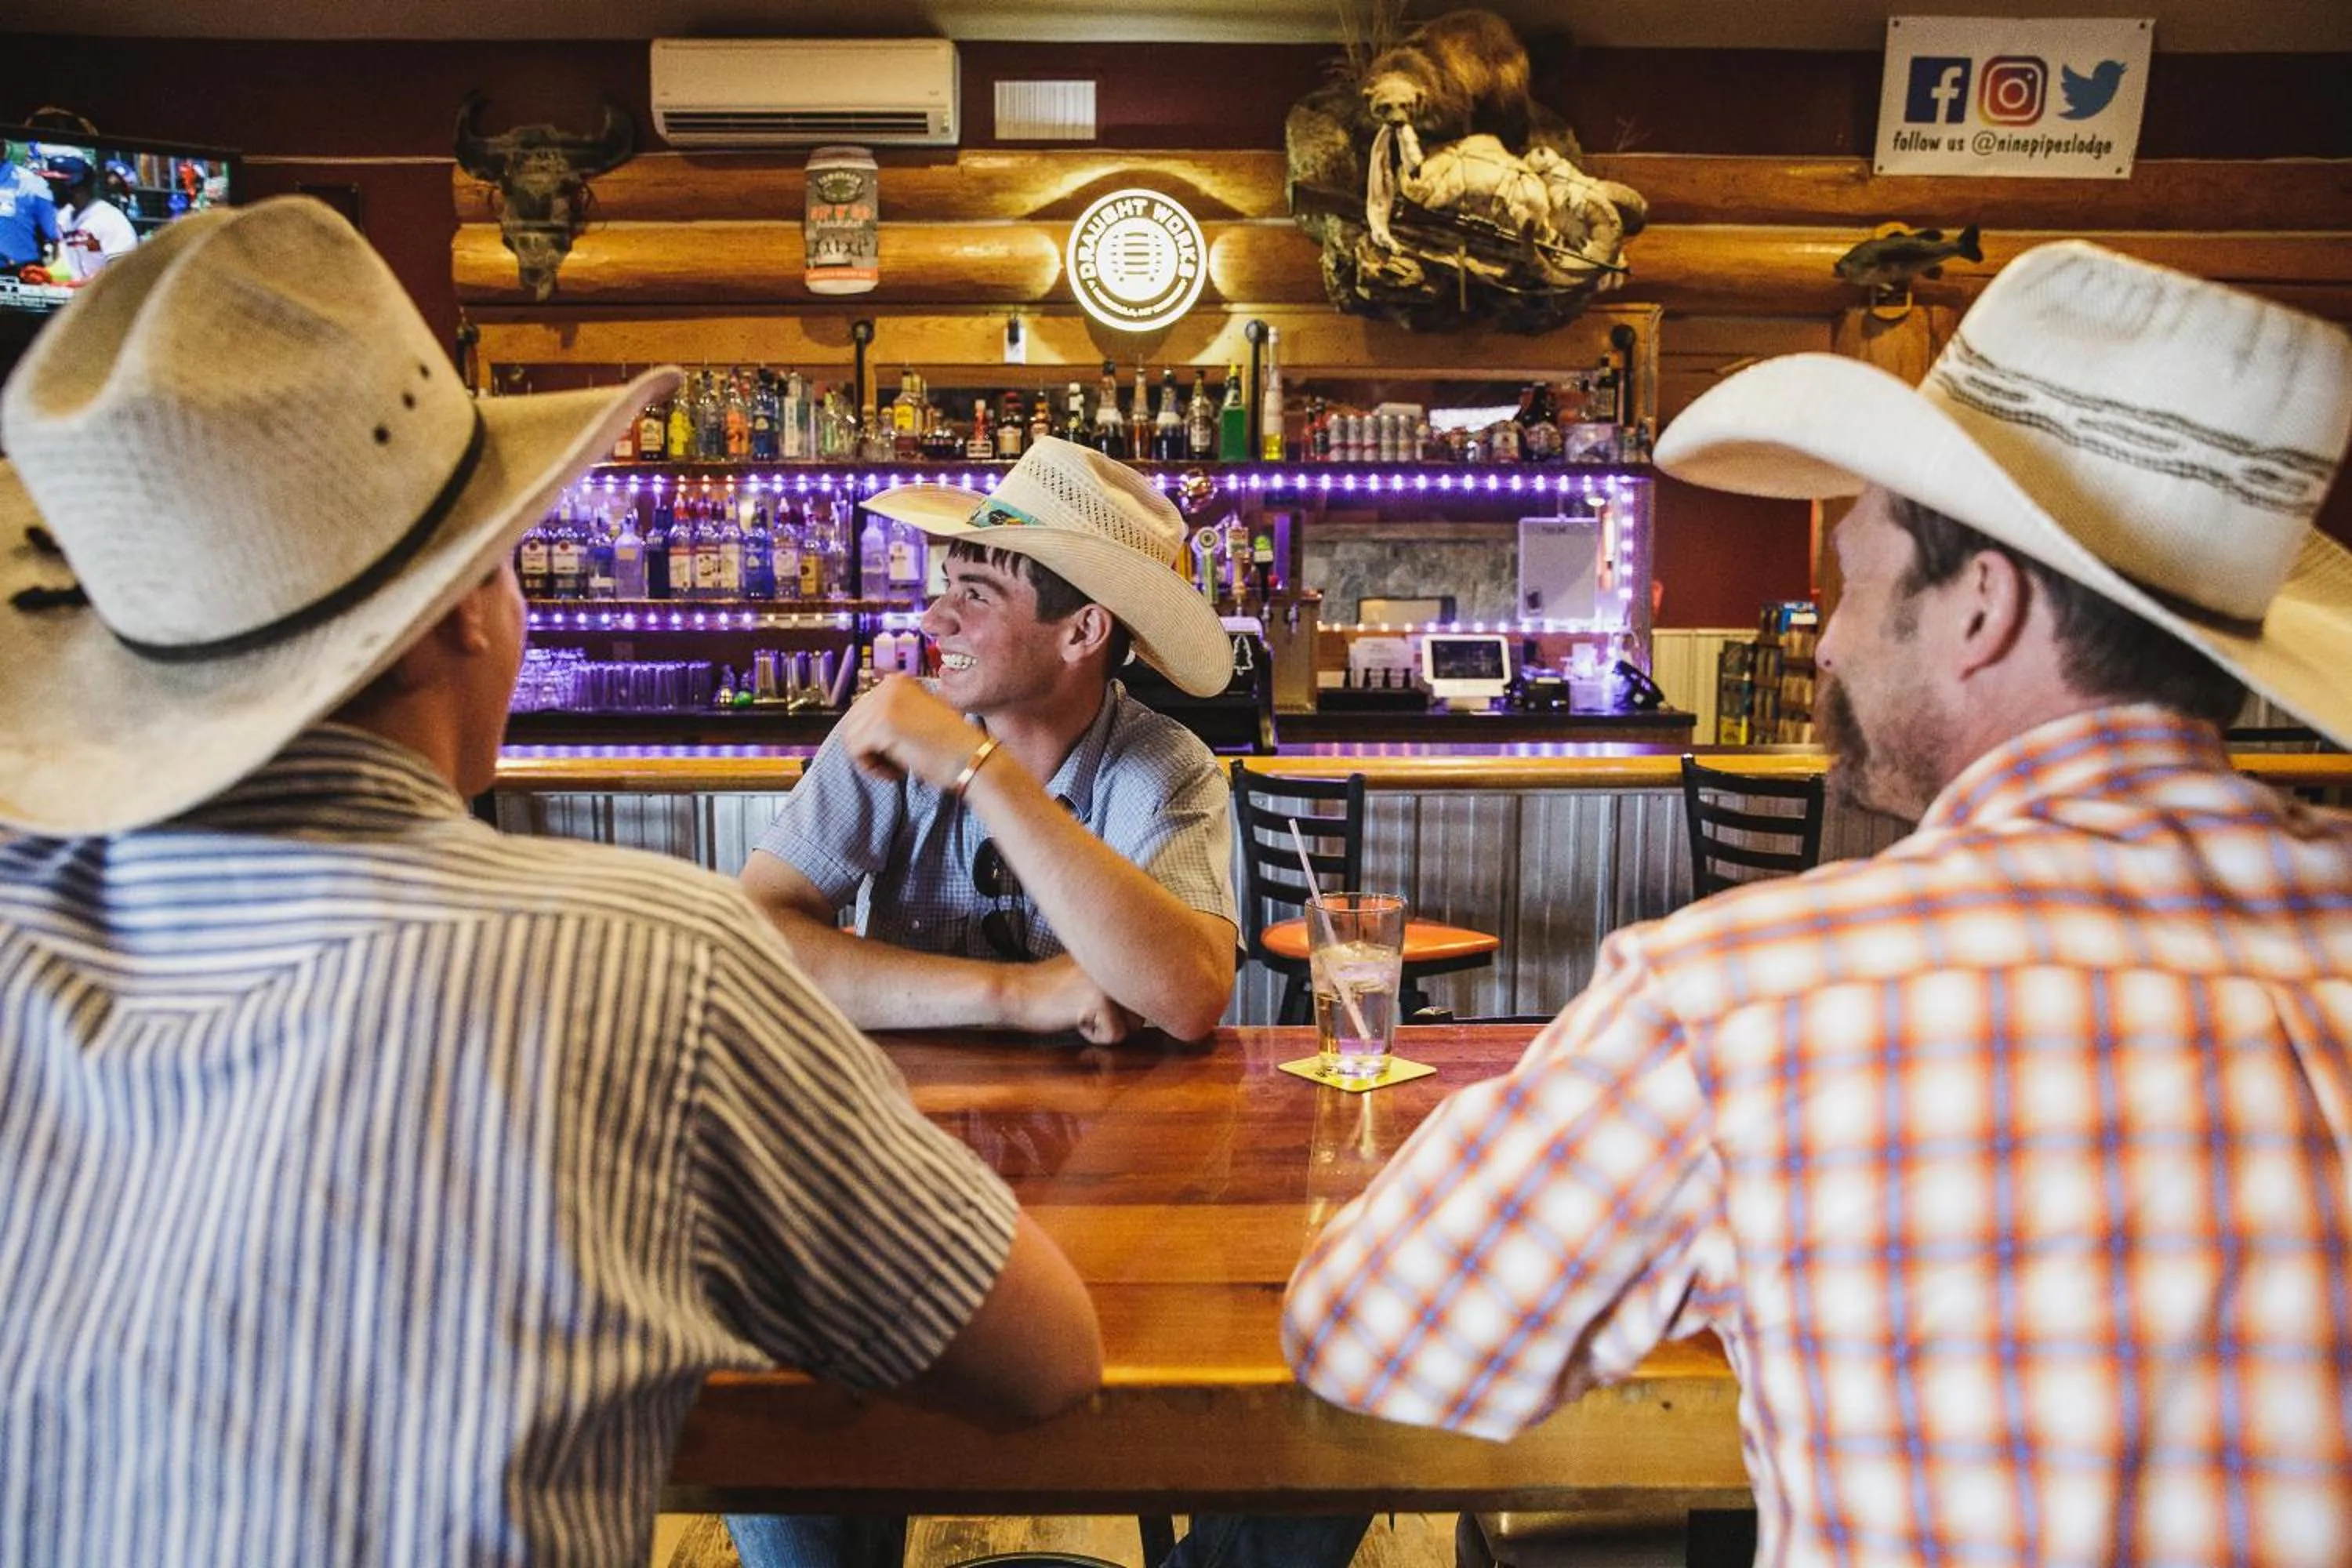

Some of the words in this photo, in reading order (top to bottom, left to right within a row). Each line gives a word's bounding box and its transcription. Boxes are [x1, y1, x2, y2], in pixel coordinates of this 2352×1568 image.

[1893, 131, 1941, 152] follow
[1947, 136, 1965, 152] us
[1971, 130, 2113, 159] @ninepipeslodge
[1077, 198, 1149, 280] DRAUGHT
[1152, 202, 1198, 278] WORKS
